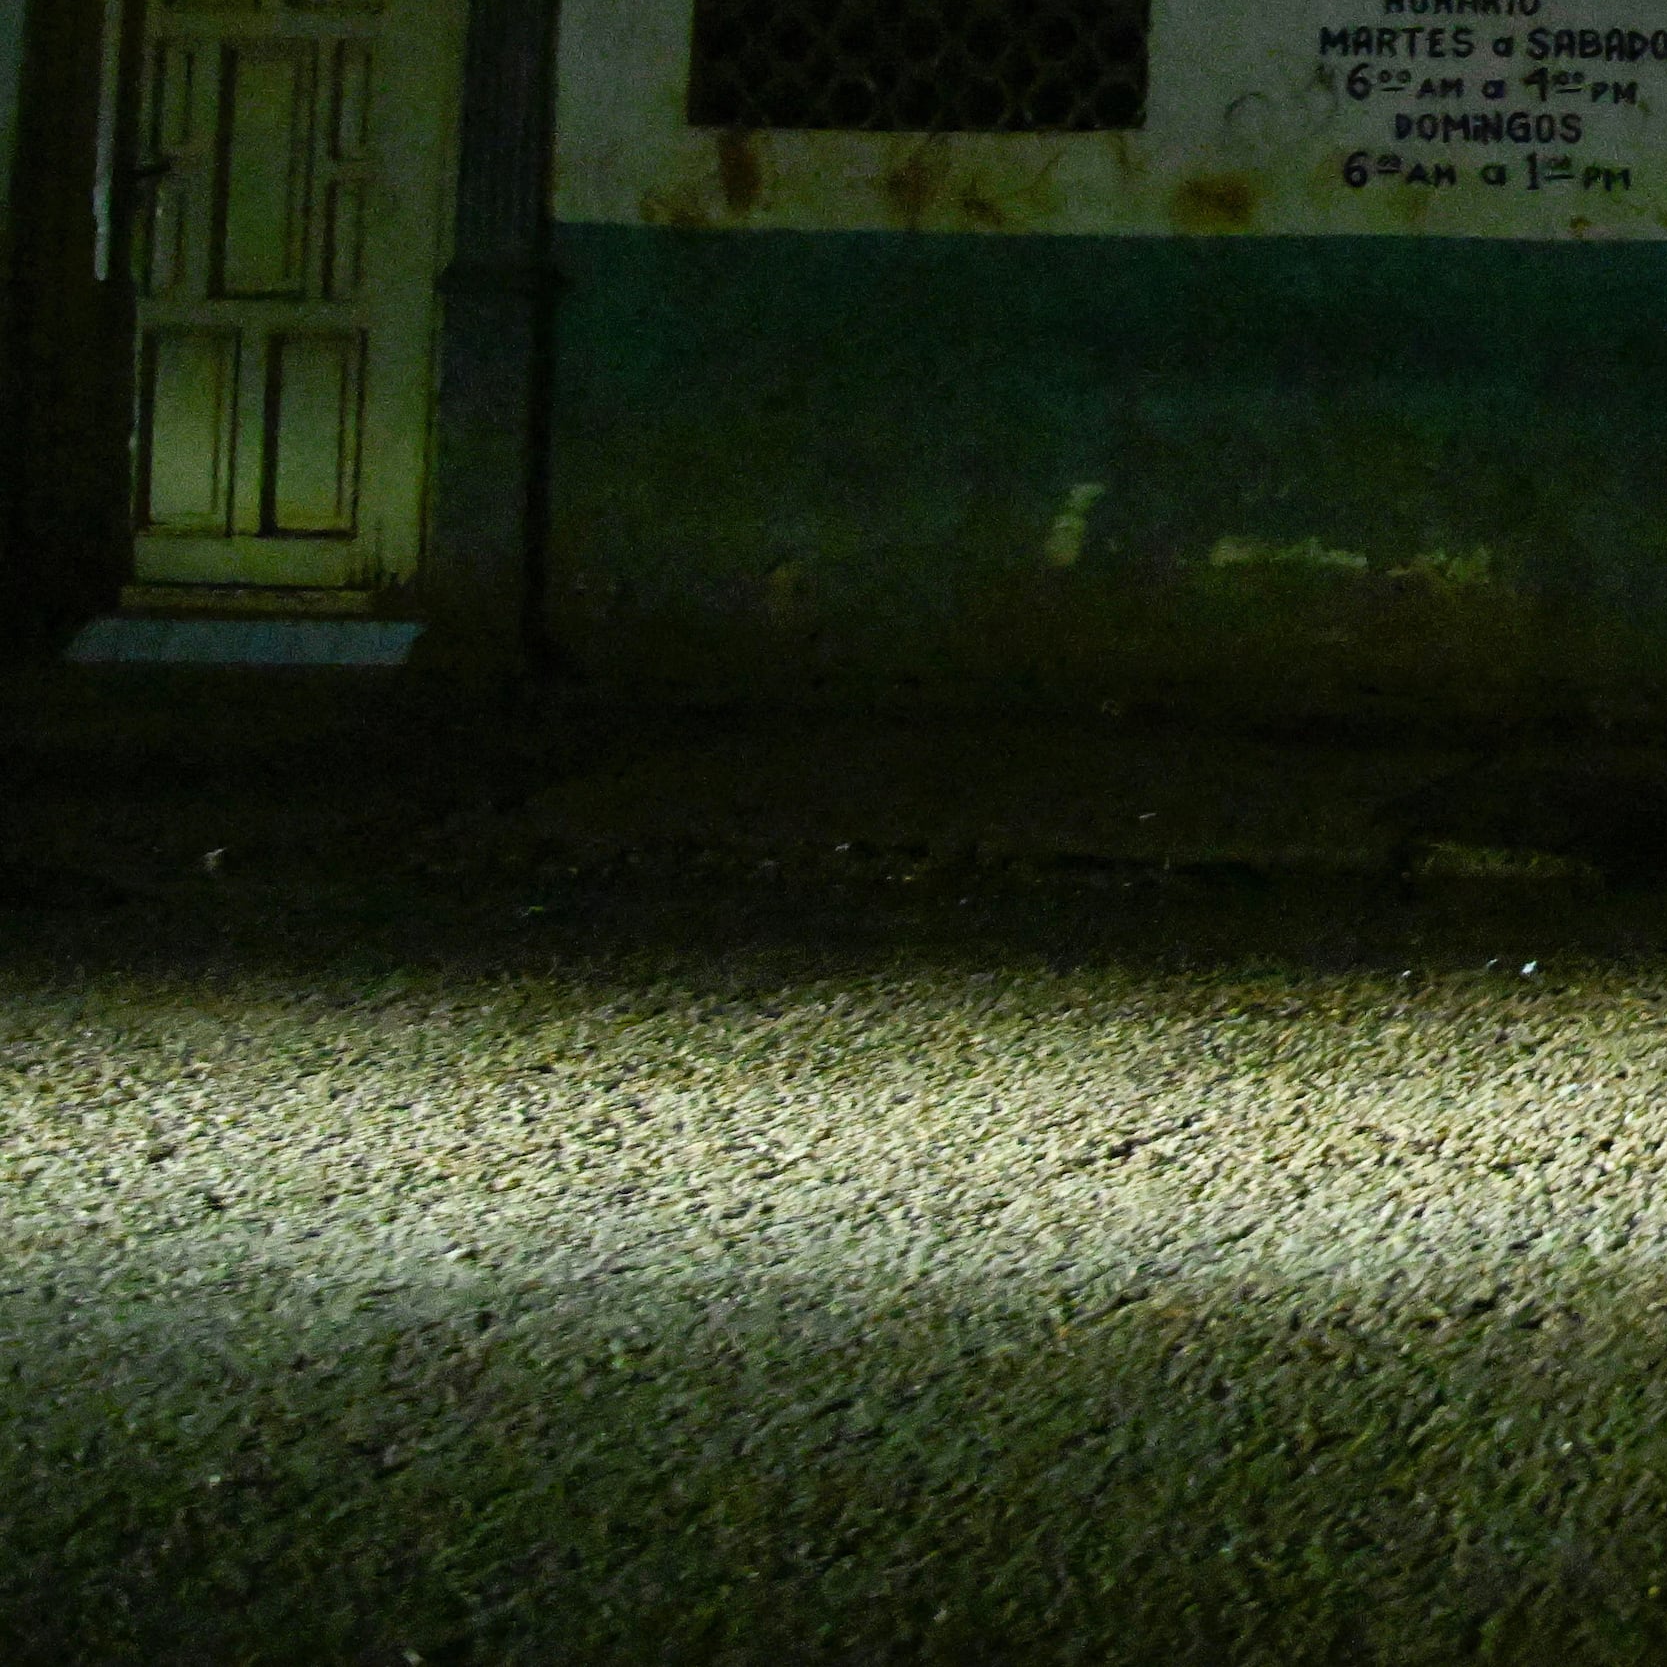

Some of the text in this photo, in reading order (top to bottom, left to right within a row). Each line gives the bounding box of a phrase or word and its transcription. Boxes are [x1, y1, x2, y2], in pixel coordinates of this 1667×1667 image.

[1318, 27, 1475, 58] MARTES
[1492, 34, 1513, 56] a
[1416, 77, 1465, 100] AM
[1481, 79, 1506, 100] a
[1591, 81, 1638, 105] PM
[1406, 162, 1457, 187] AM
[1480, 165, 1507, 186] a
[1583, 166, 1633, 192] PM
